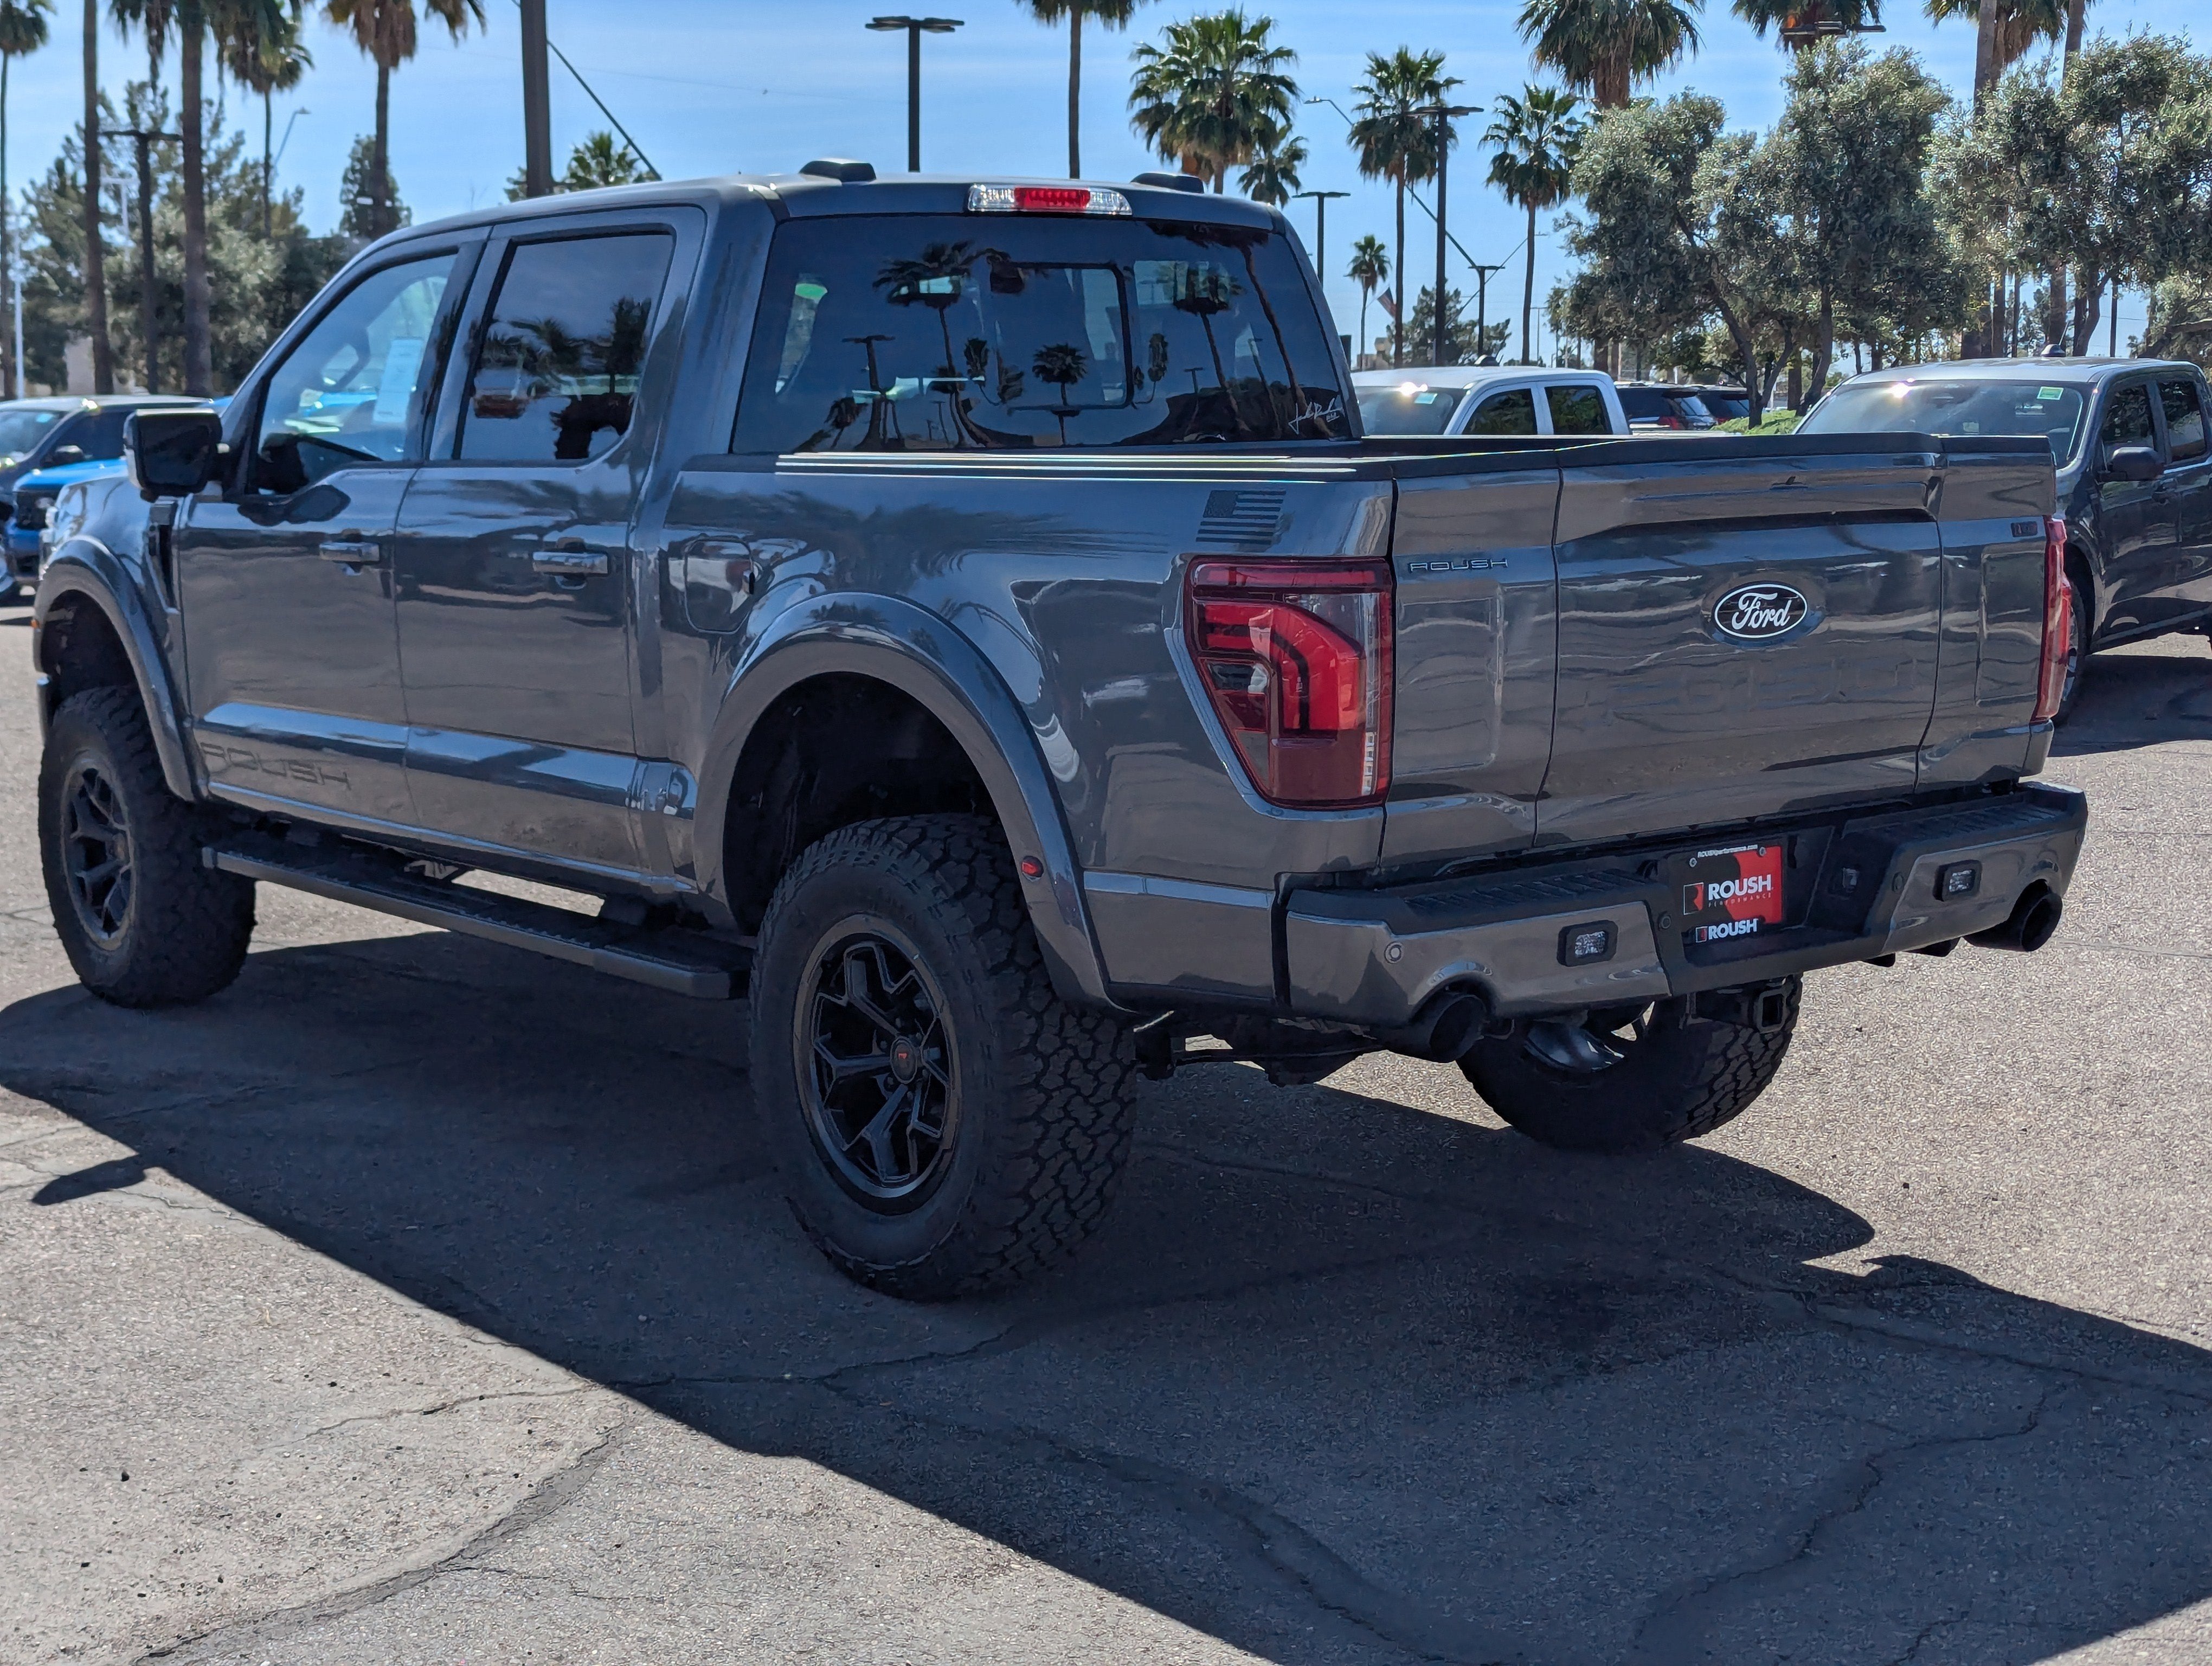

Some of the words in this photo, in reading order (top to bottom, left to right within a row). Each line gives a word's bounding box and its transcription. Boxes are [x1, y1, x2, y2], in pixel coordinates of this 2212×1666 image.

[1410, 558, 1509, 572] ROUSH
[1732, 592, 1792, 630] Ford
[200, 741, 351, 791] ROUSH
[1708, 874, 1772, 901] ROUSH
[1708, 918, 1759, 940] ROUSH
